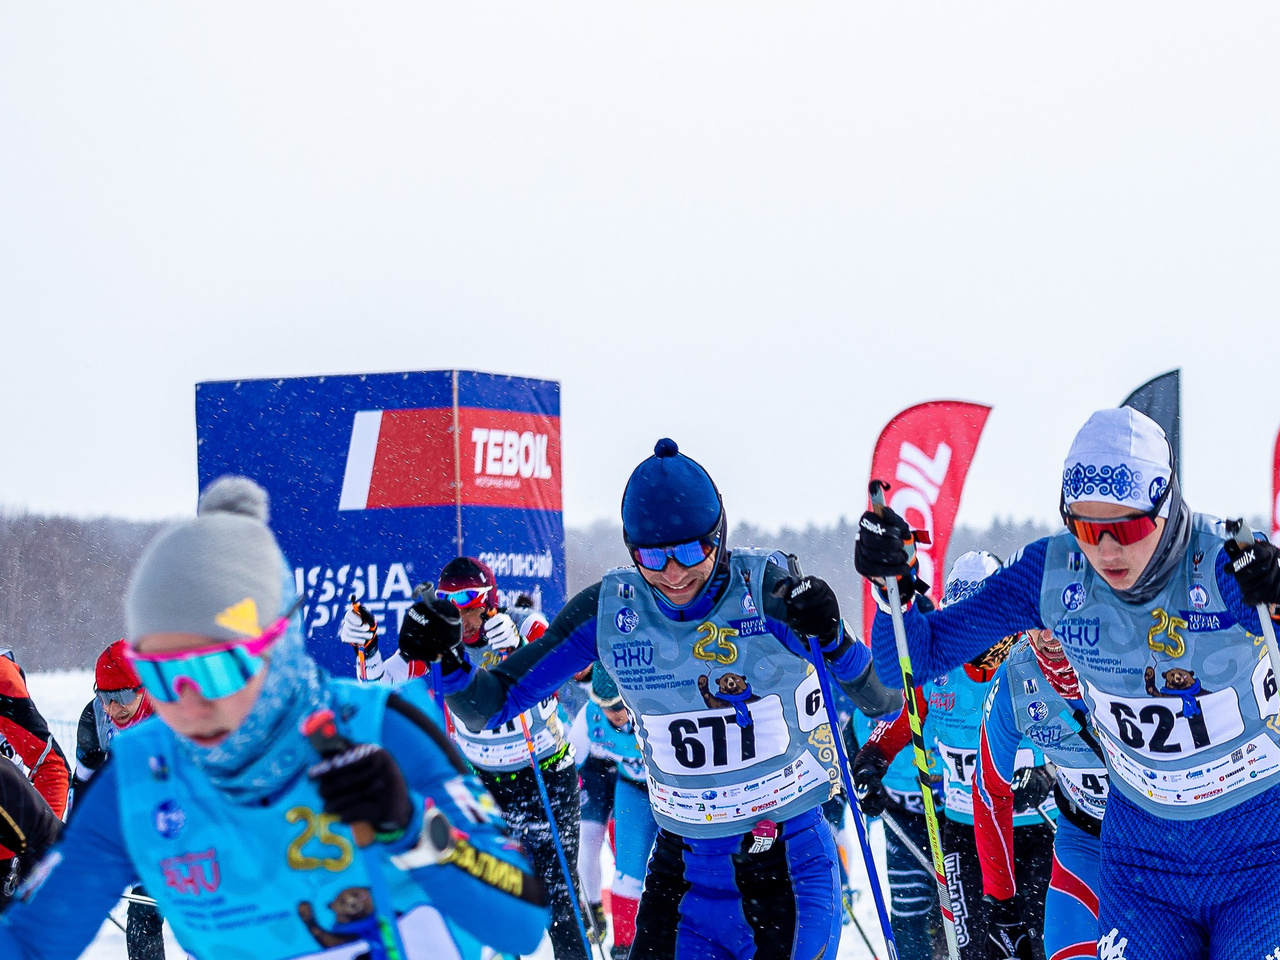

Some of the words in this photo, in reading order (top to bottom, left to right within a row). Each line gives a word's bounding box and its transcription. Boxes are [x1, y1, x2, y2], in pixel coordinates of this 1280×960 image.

[472, 426, 552, 480] TEBOIL
[692, 622, 739, 666] 25
[1147, 607, 1189, 658] 25
[667, 710, 757, 770] 677
[1109, 699, 1214, 754] 621
[285, 805, 354, 873] 25
